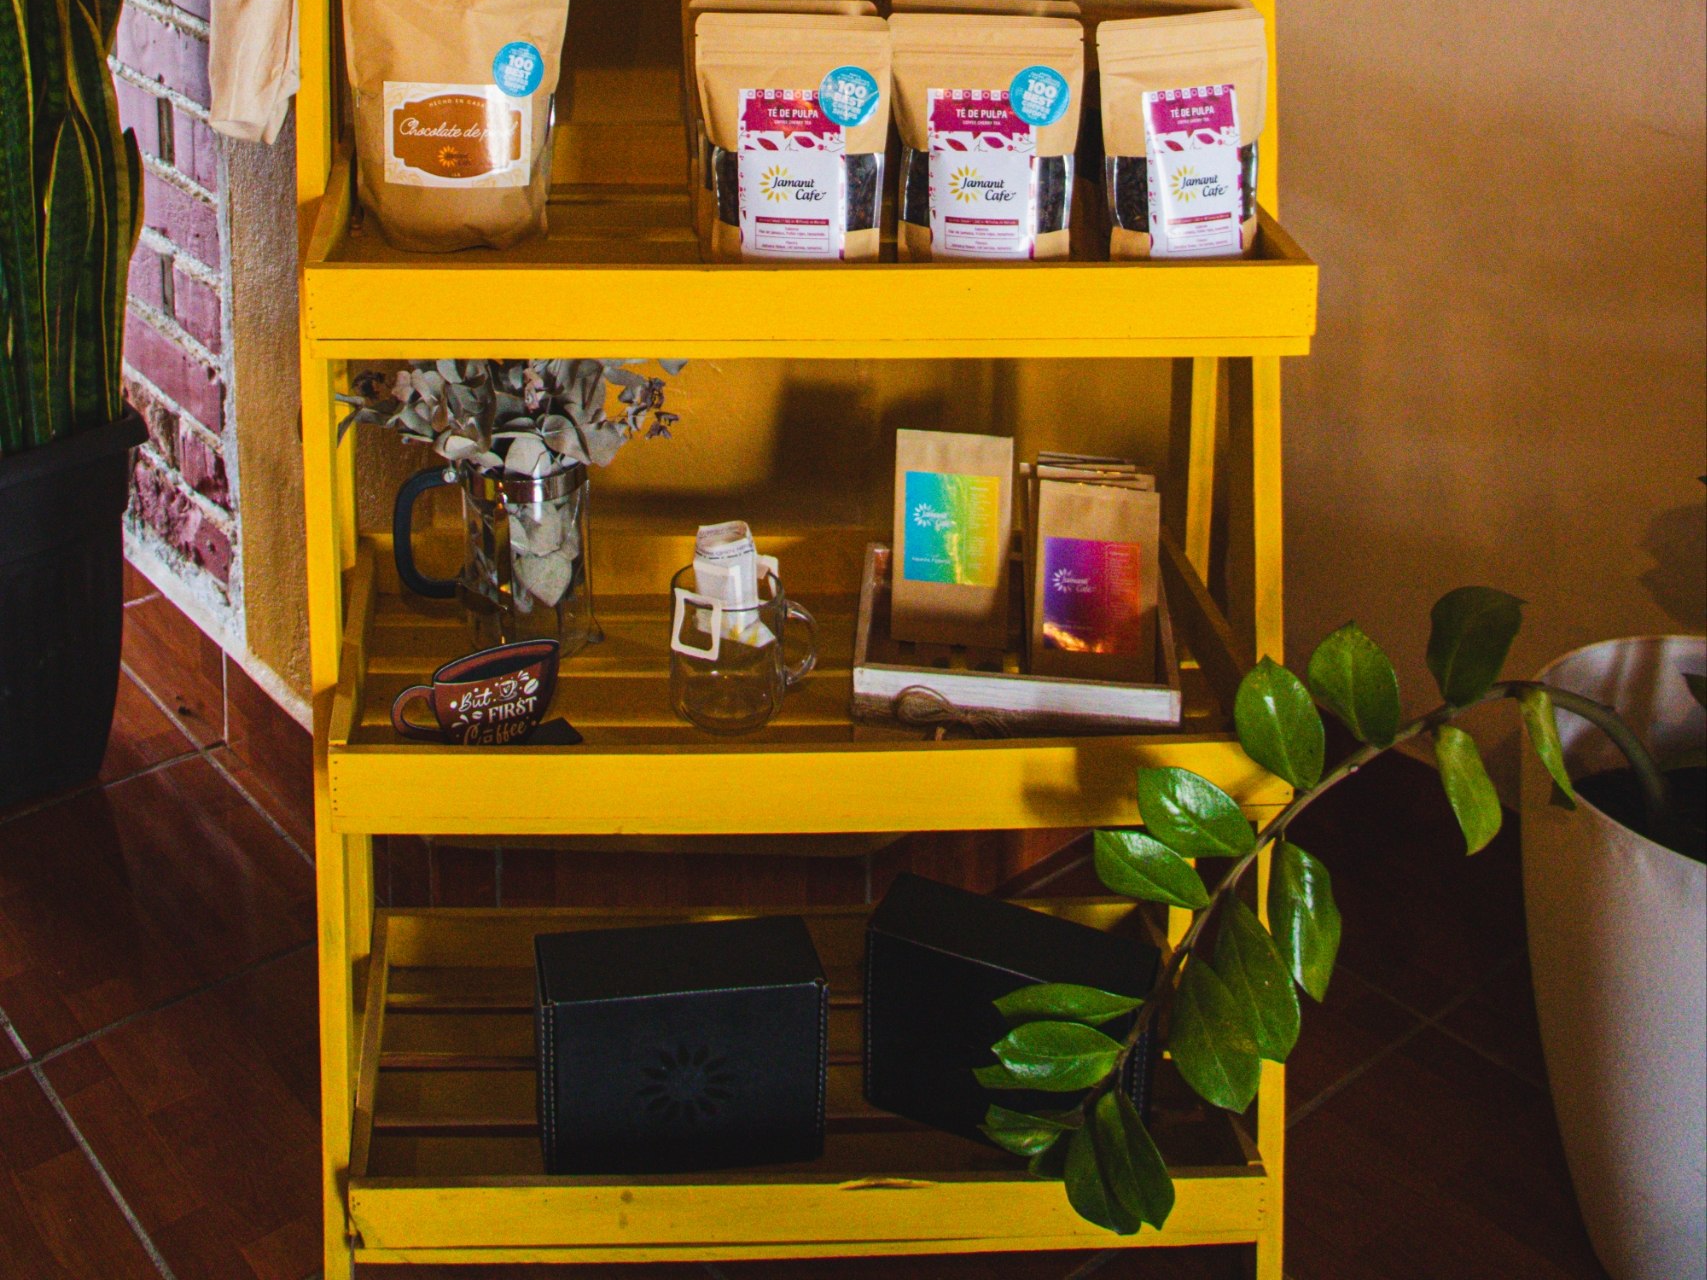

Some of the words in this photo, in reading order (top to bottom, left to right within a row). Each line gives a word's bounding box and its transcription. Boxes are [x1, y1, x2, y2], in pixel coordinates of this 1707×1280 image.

[508, 54, 534, 71] 100
[838, 80, 867, 98] 100
[1028, 80, 1057, 99] 100
[779, 108, 790, 118] DE
[792, 109, 819, 118] PULPA
[968, 109, 979, 118] DE
[981, 109, 1008, 119] PULPA
[1180, 108, 1191, 118] DE
[1191, 105, 1215, 117] PULPA
[400, 117, 462, 138] Chocolate
[464, 122, 481, 138] de
[459, 688, 493, 713] But
[488, 697, 538, 724] FIRST
[464, 720, 528, 746] Coffee
